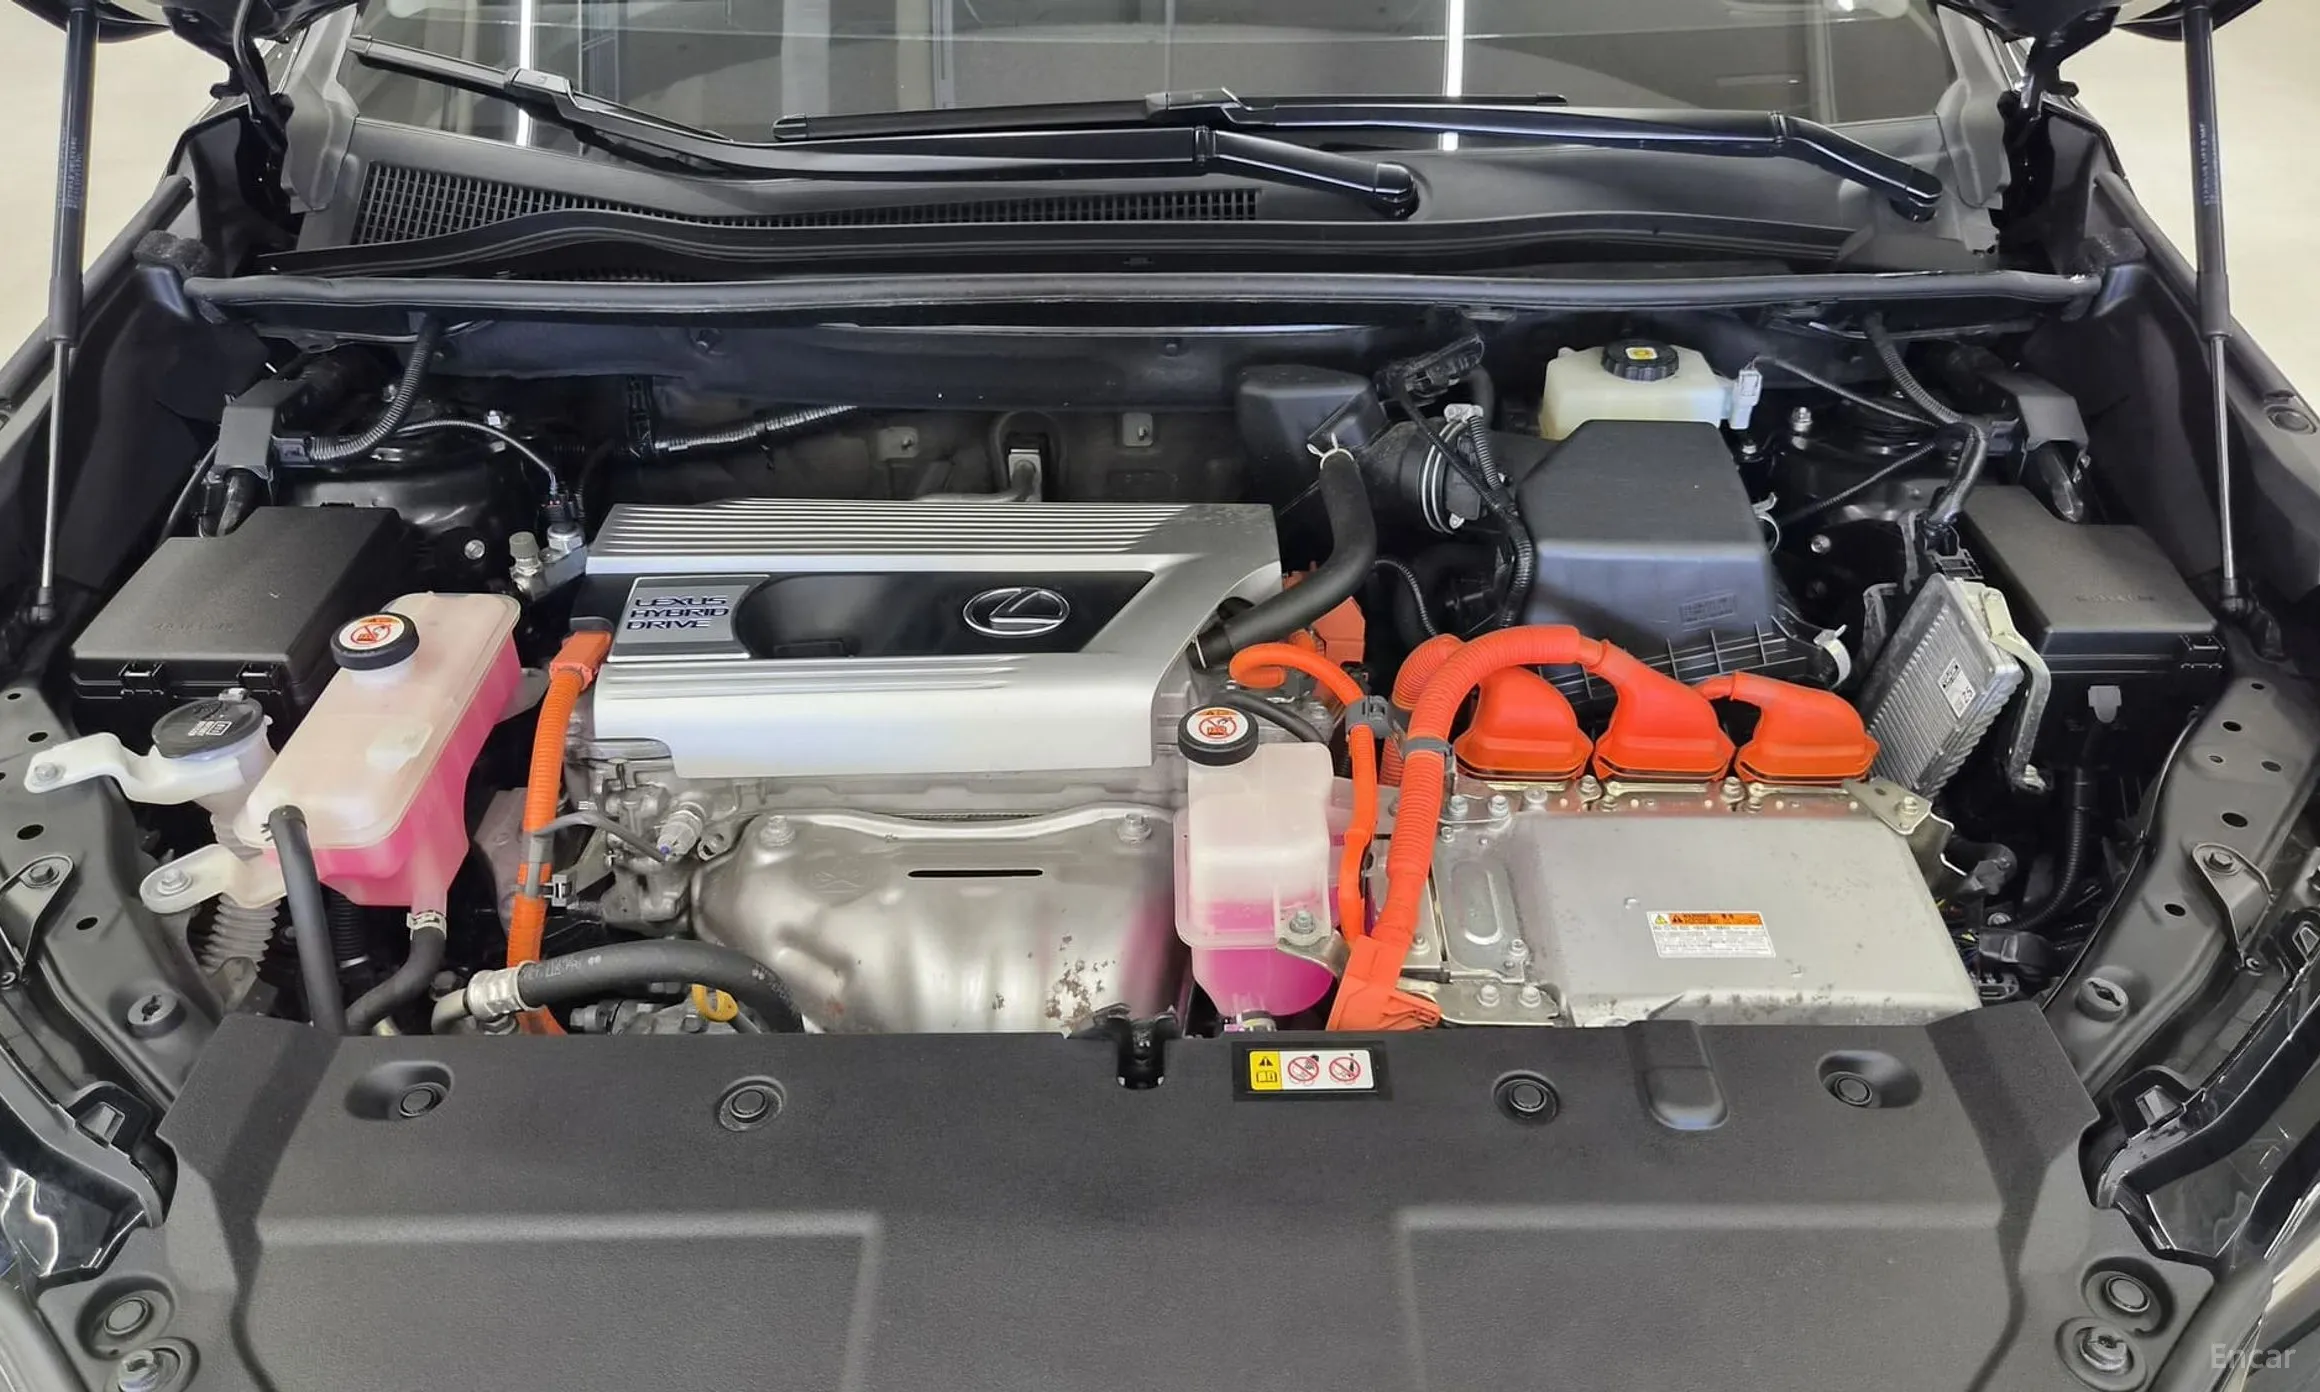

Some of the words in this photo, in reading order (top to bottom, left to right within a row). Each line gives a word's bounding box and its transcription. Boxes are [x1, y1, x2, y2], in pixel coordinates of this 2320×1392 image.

[636, 596, 727, 606] LEXUS
[630, 606, 730, 618] HYBRID
[627, 619, 710, 629] DRIVE
